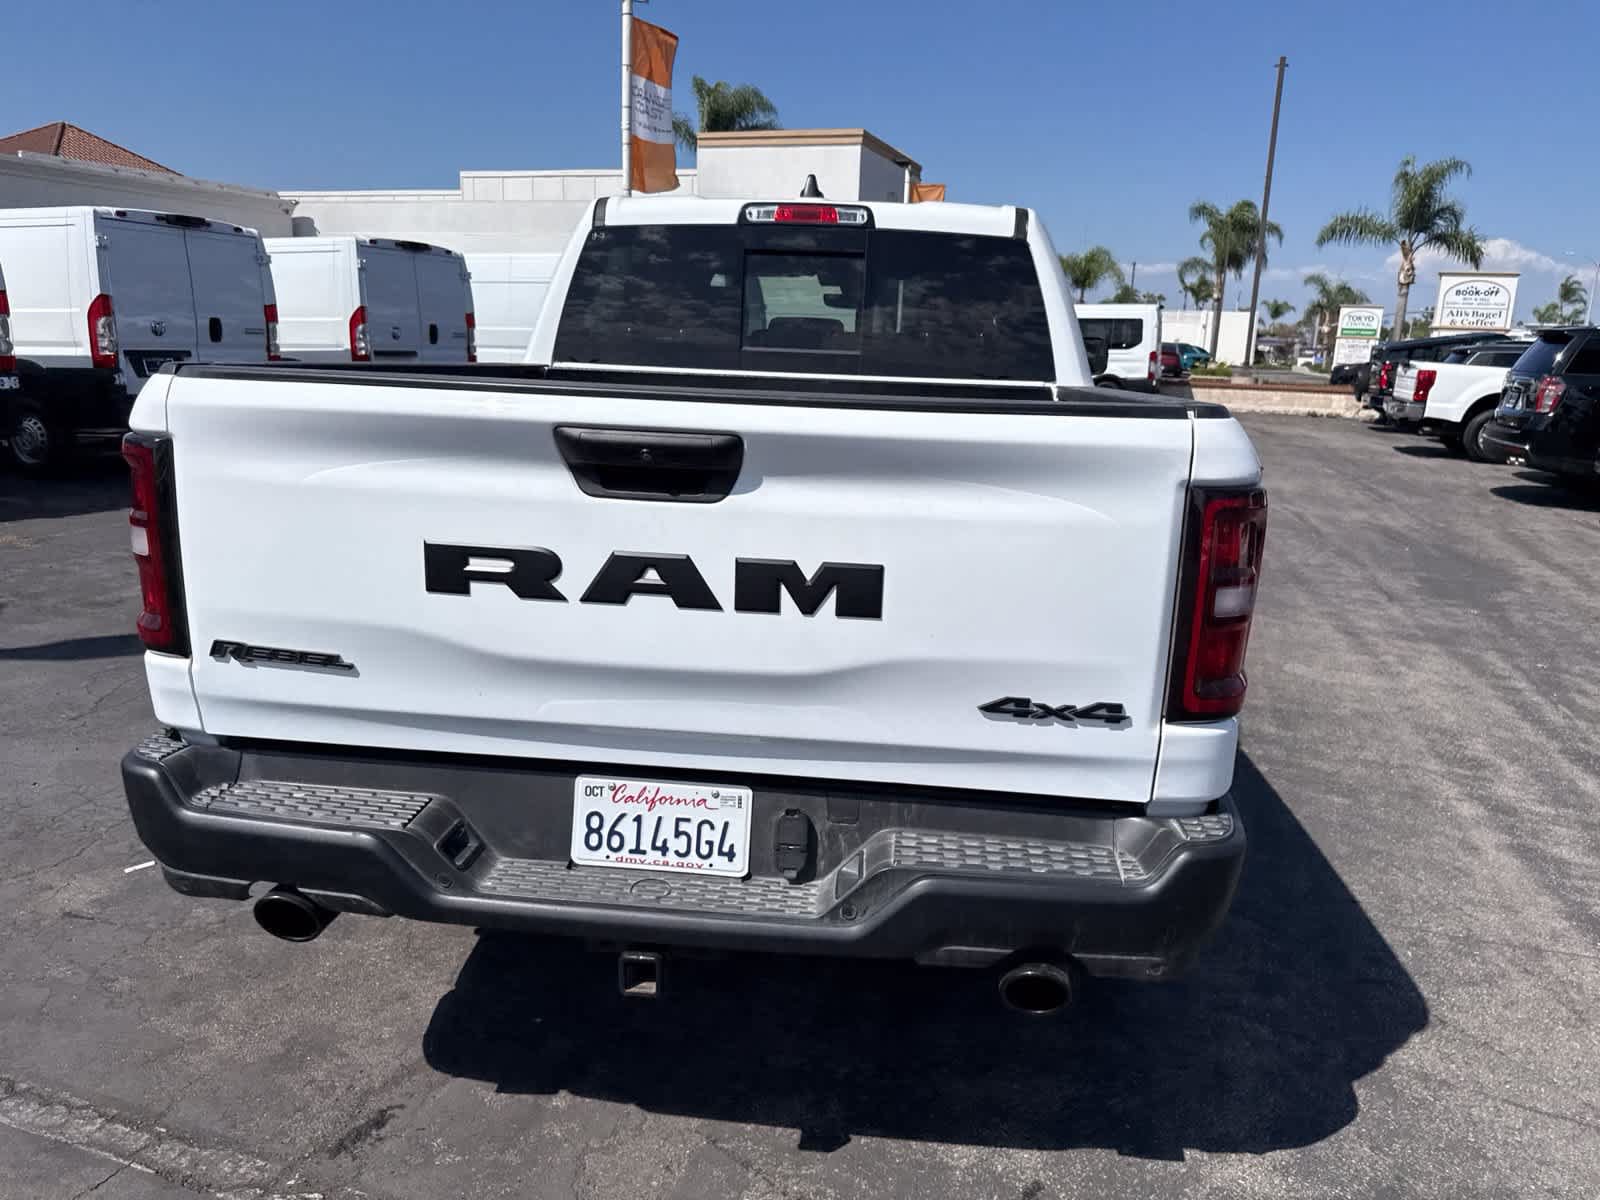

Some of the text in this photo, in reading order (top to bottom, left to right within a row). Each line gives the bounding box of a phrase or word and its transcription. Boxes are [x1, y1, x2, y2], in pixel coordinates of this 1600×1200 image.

[423, 538, 885, 620] RAM
[209, 639, 357, 673] REBEL
[584, 784, 605, 798] OCT
[611, 783, 719, 812] California
[584, 810, 736, 863] 86145G4
[615, 855, 705, 870] dmv.ca.gov
